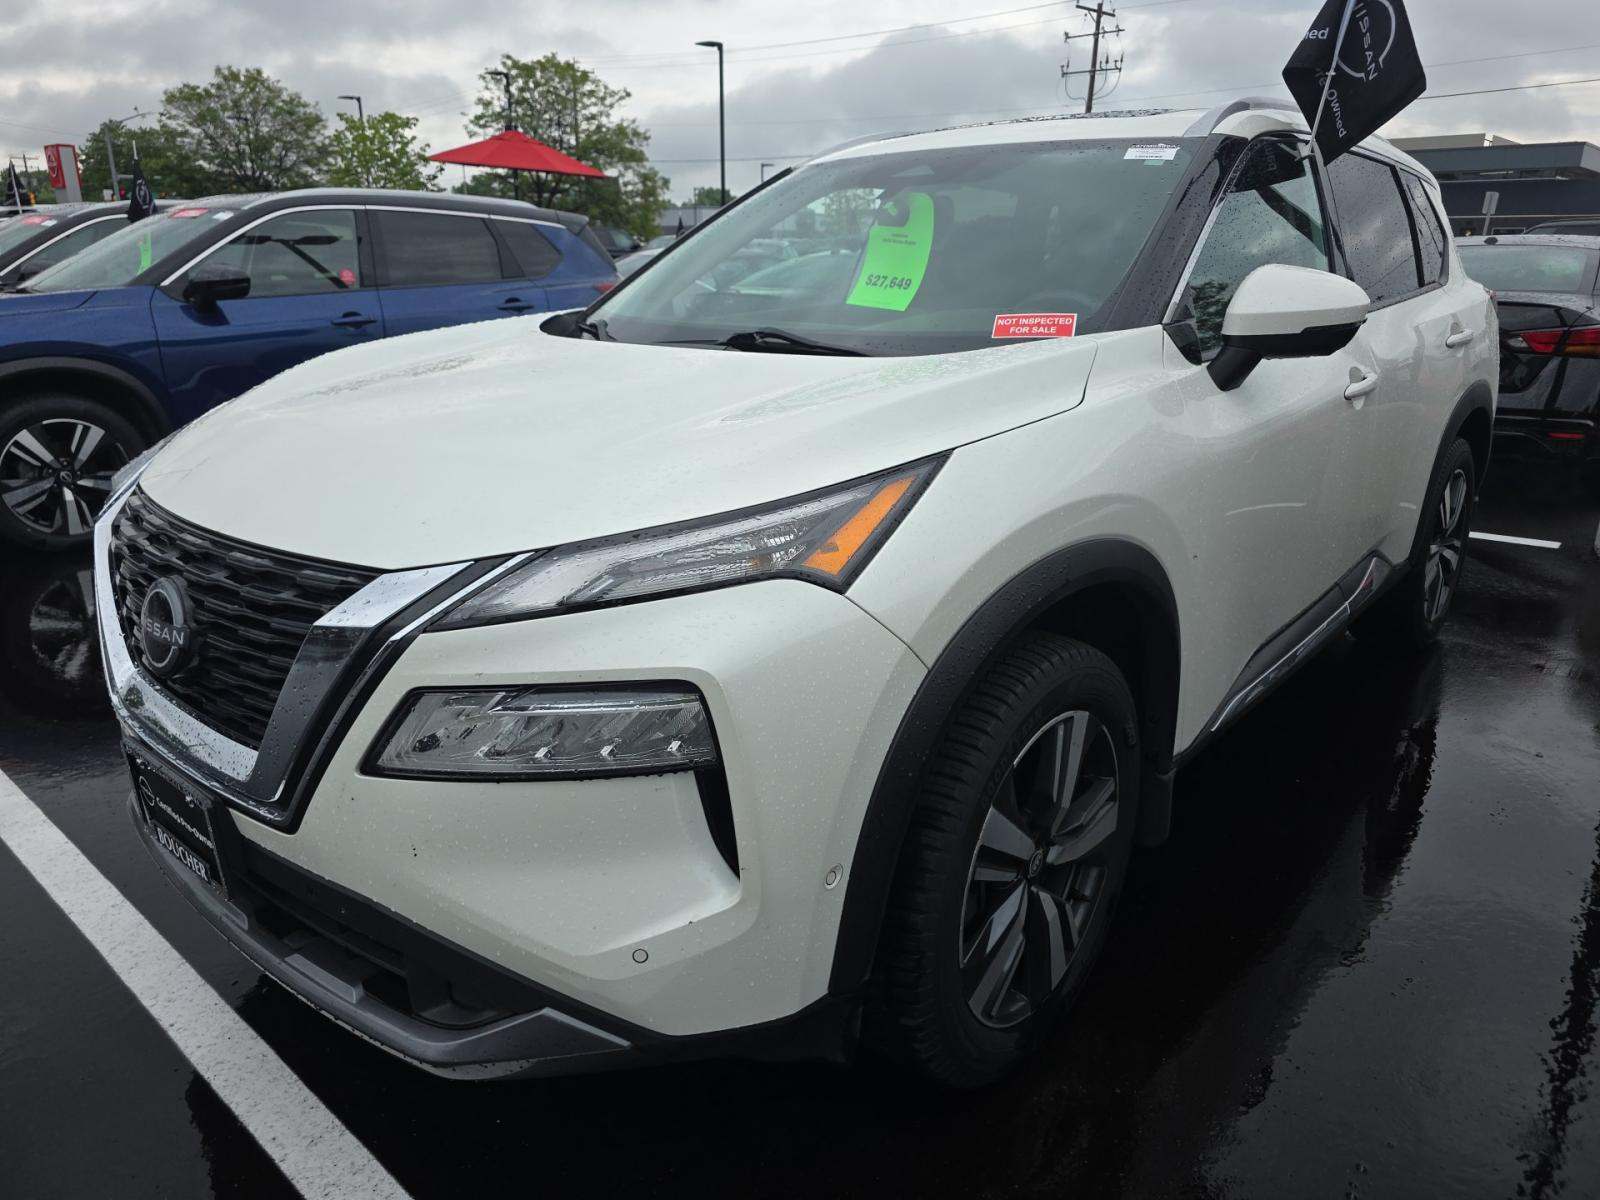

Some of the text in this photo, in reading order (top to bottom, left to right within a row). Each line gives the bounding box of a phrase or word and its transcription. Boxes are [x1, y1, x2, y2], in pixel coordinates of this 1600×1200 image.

[1326, 88, 1348, 138] Owned
[865, 274, 912, 290] $27,649
[997, 317, 1072, 326] NOT INSPECTED
[145, 618, 185, 645] SSAN
[157, 827, 209, 882] BOUCHER
